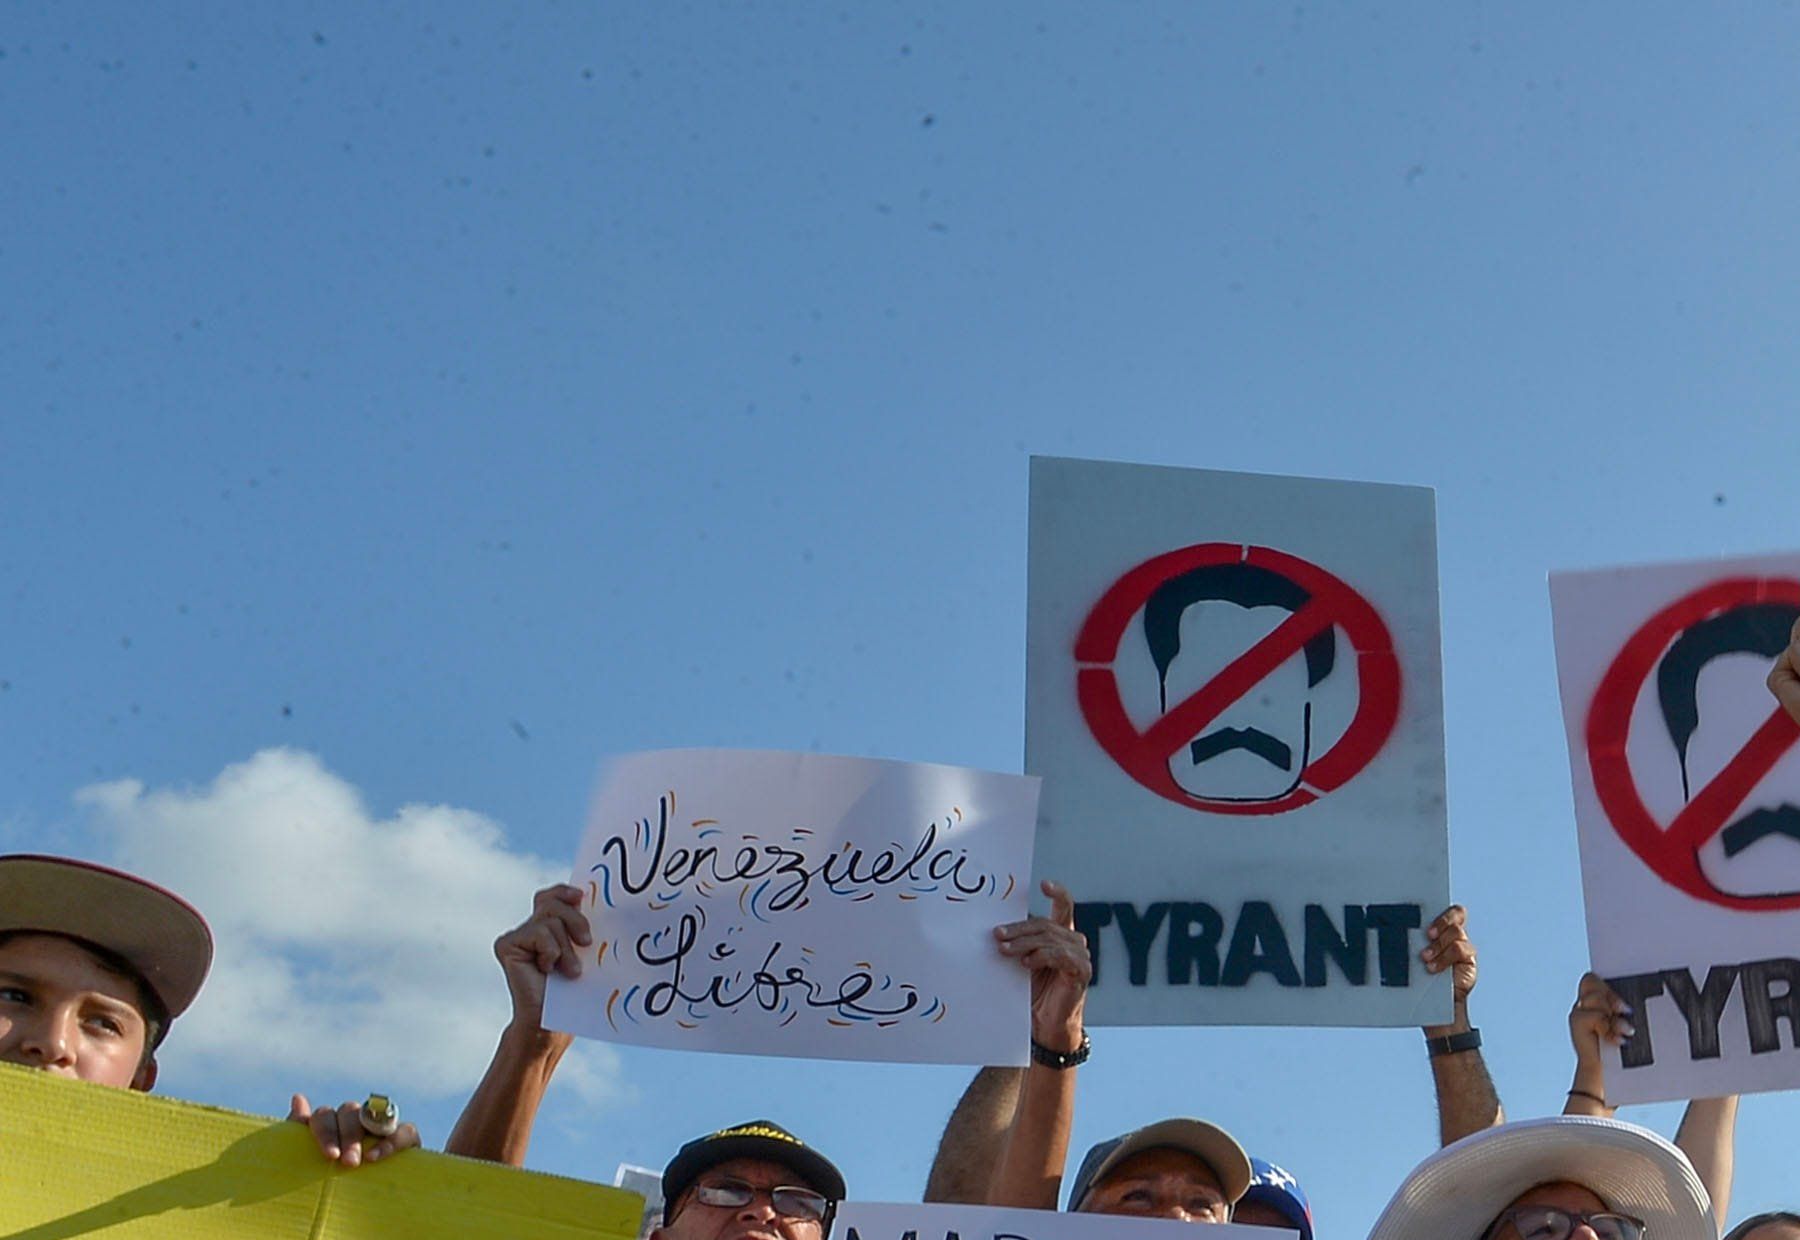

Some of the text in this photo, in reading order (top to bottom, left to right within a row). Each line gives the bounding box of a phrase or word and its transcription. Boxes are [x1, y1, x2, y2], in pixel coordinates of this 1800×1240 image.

[602, 796, 987, 912] Venezuela
[635, 913, 918, 1017] Libre
[1073, 901, 1422, 987] TYRANT
